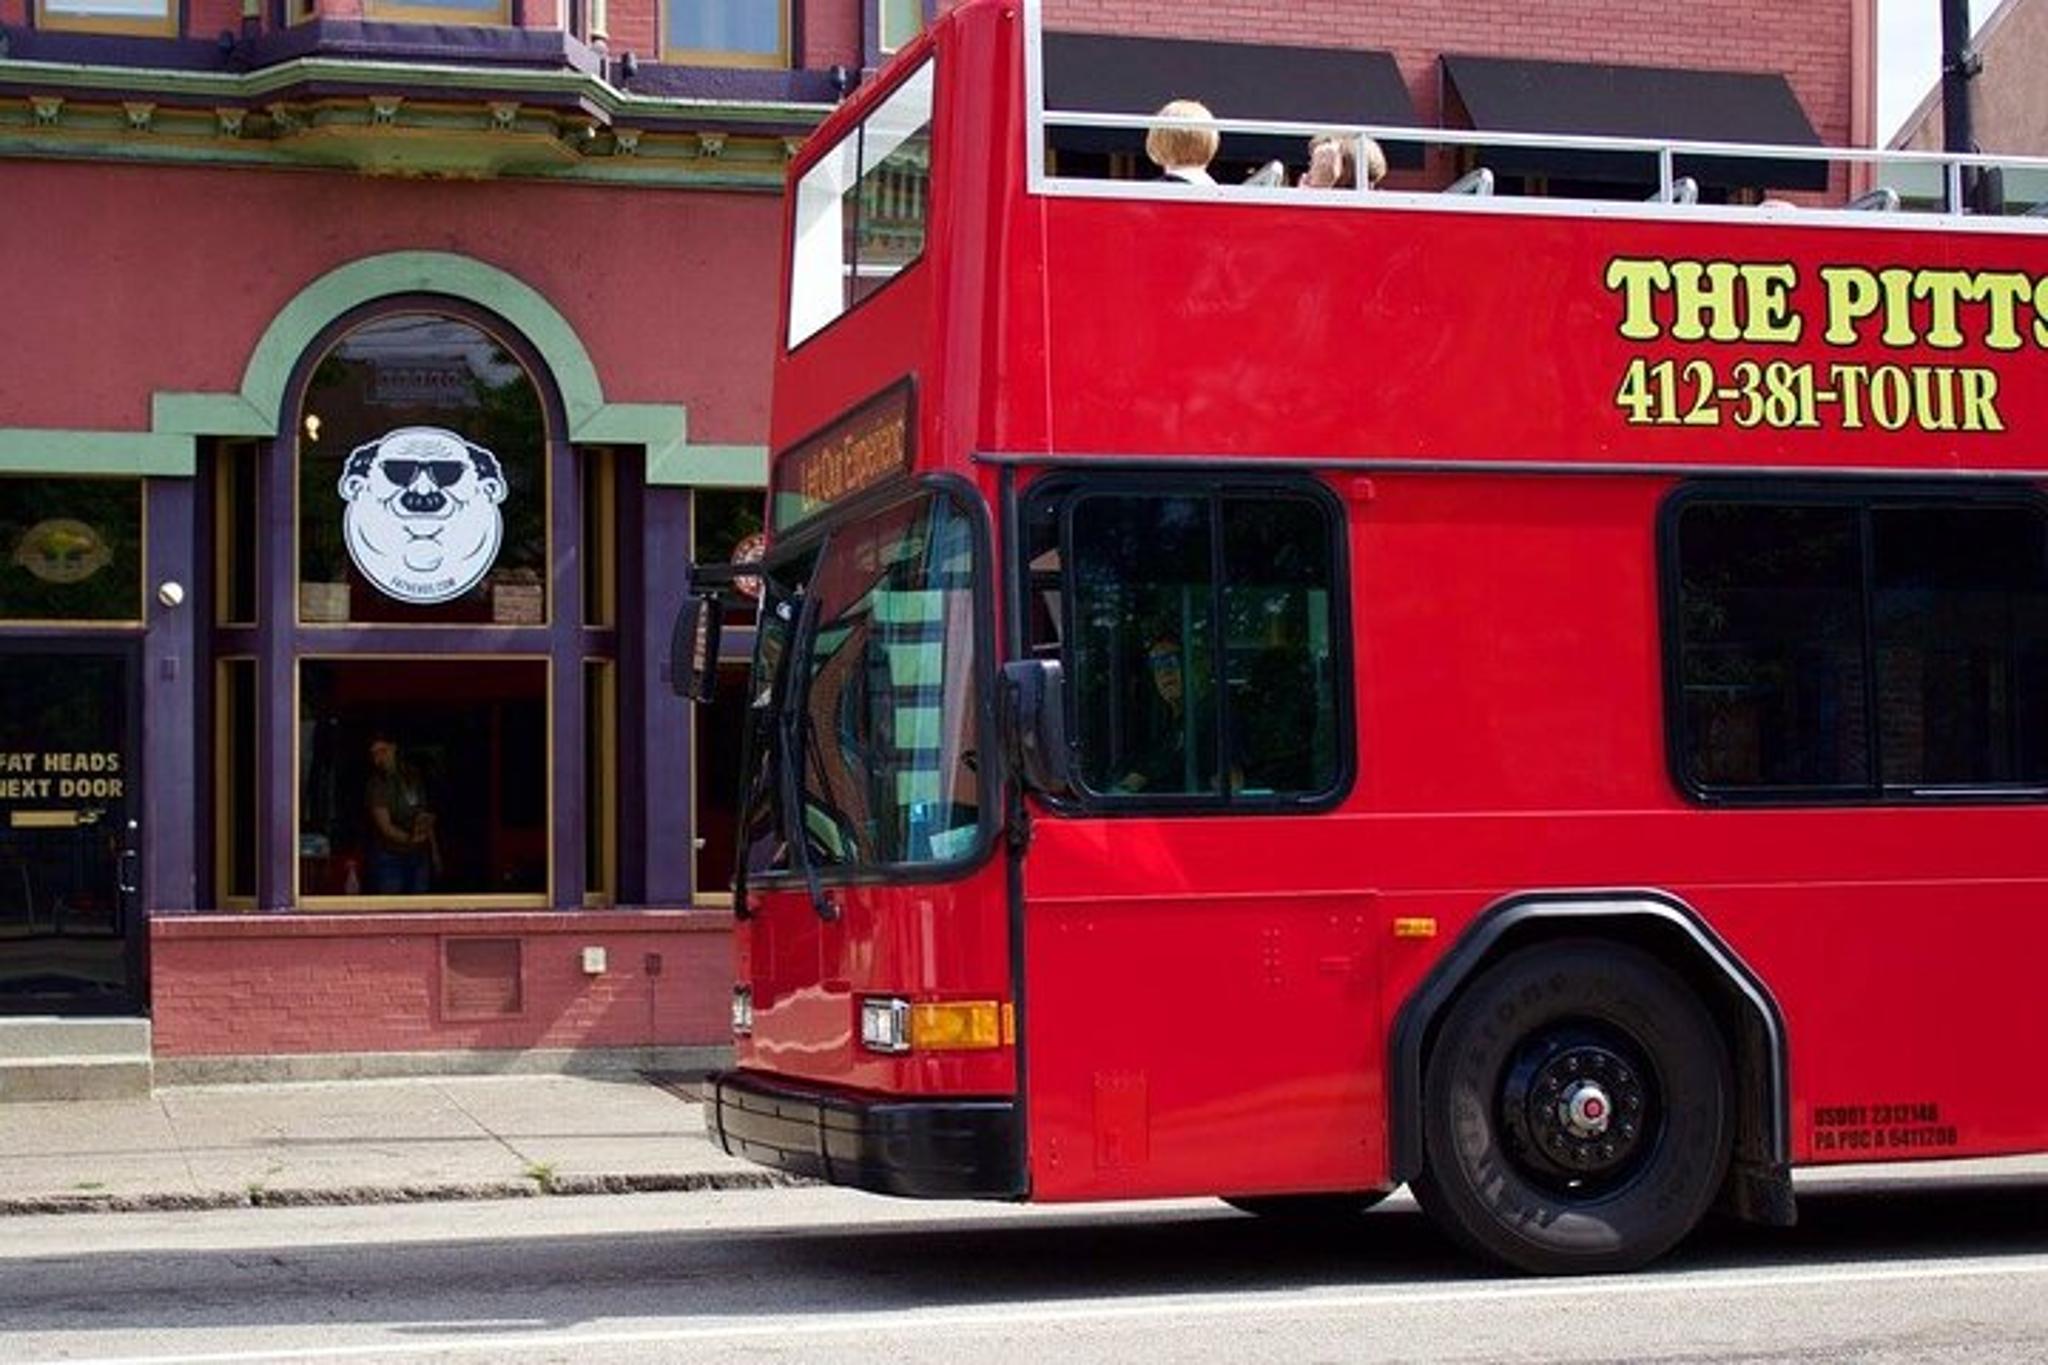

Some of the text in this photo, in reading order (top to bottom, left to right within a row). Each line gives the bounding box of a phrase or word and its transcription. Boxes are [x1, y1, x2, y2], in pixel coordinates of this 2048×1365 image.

[1606, 258, 1803, 344] THE
[1616, 358, 2006, 432] 412-381-TOUR
[44, 753, 119, 772] HEADS
[59, 779, 123, 798] DOOR
[1814, 1130, 1835, 1149] PA
[1837, 1129, 1870, 1148] PUC
